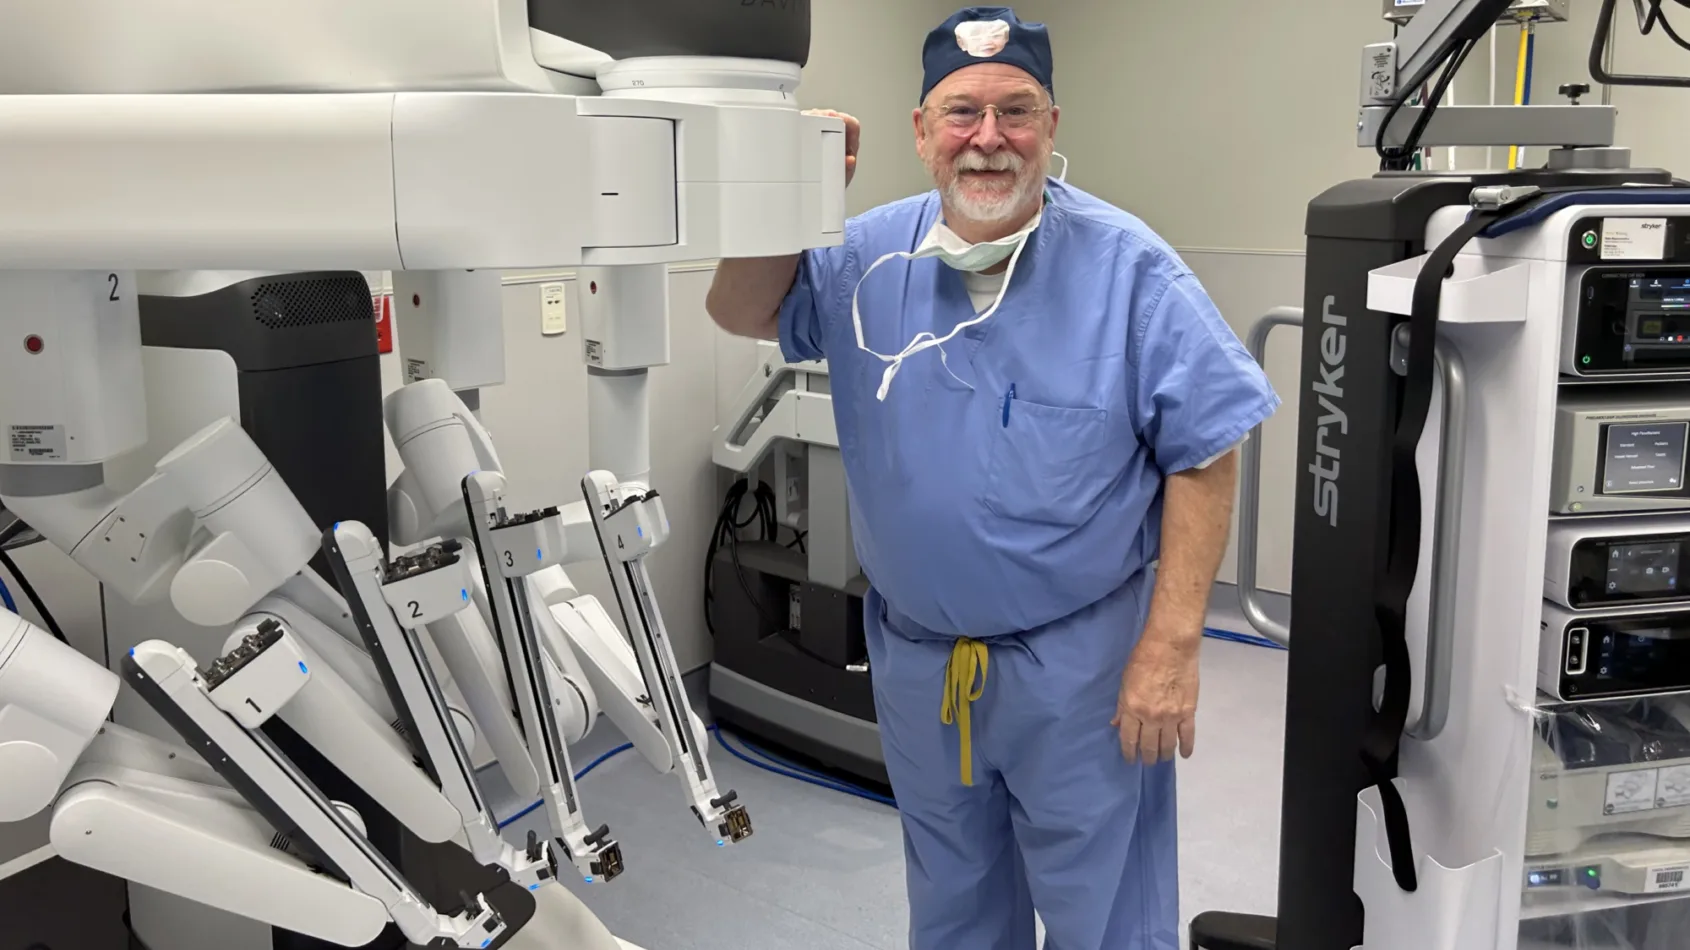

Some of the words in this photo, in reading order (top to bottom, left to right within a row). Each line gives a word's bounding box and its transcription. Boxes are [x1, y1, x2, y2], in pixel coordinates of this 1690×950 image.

[1641, 222, 1662, 230] stryker
[108, 273, 120, 301] 2
[1308, 295, 1348, 527] stryker
[617, 534, 625, 549] 4
[504, 550, 515, 567] 3
[407, 600, 424, 618] 2
[245, 697, 262, 714] 1
